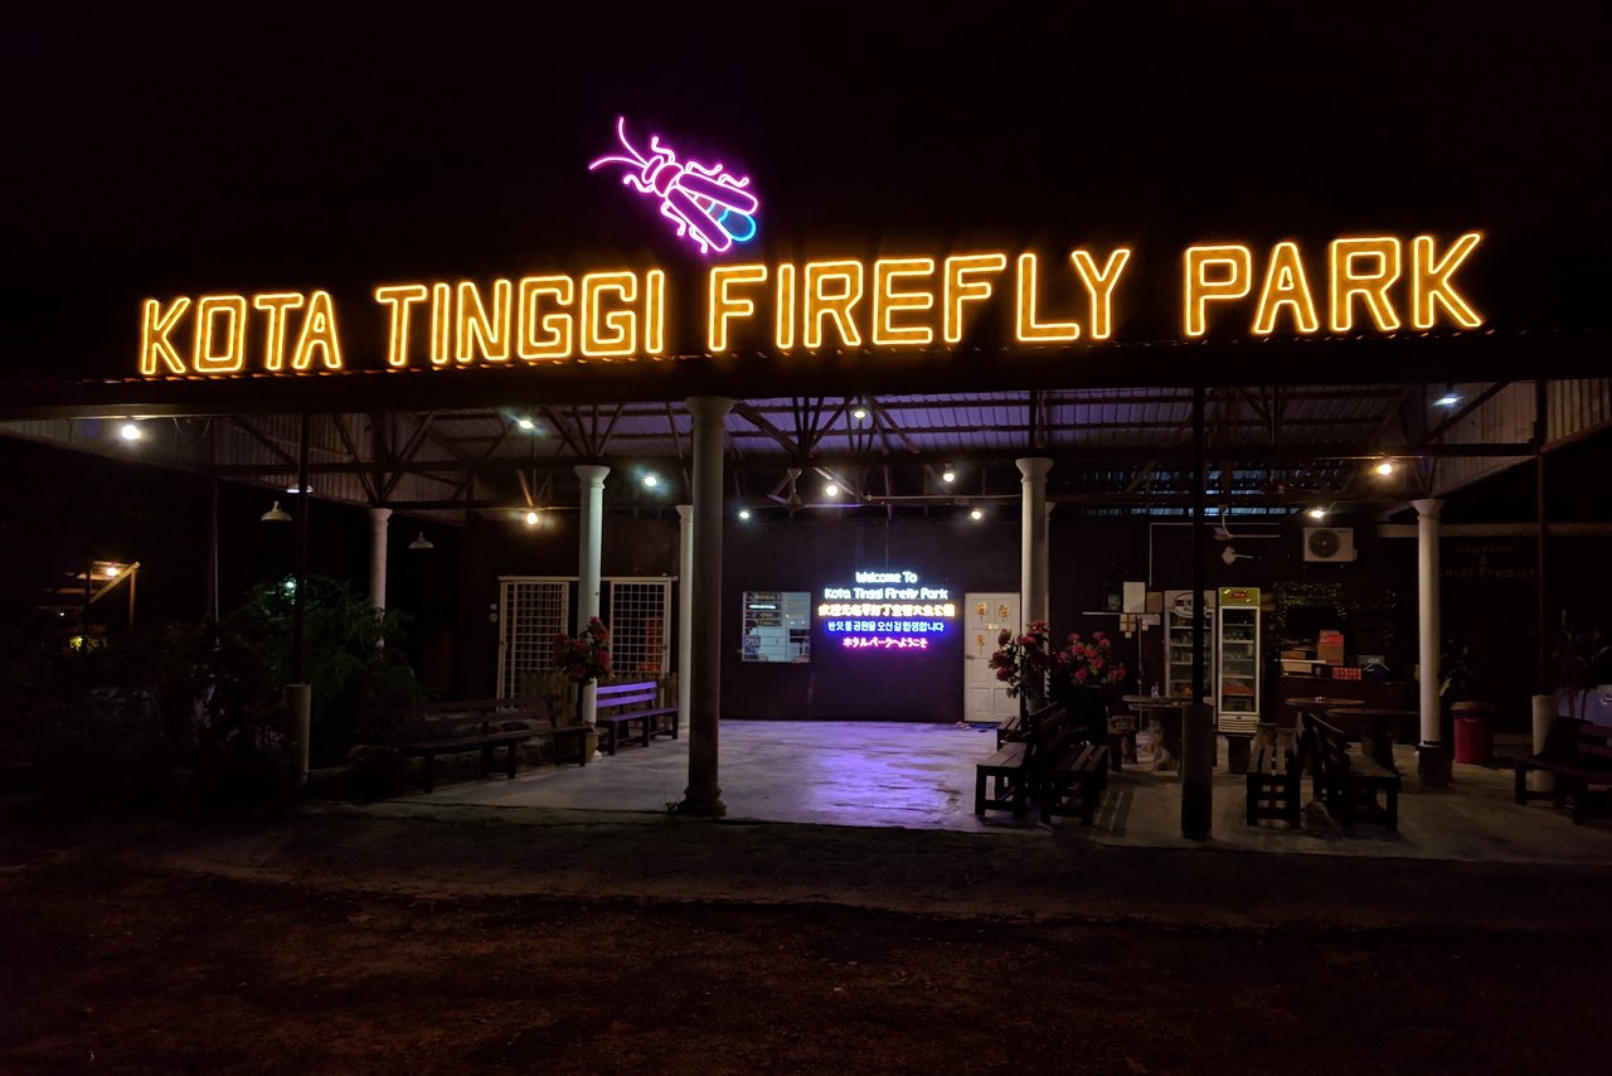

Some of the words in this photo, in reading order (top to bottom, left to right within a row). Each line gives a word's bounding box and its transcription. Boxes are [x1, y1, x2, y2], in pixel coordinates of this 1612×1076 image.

[139, 290, 343, 375] KOTA
[374, 267, 667, 368] TINGGI
[707, 247, 1132, 354] FIREFLY
[1183, 231, 1484, 338] PARK
[855, 571, 901, 583] Welcome
[902, 571, 918, 583] To
[1477, 566, 1535, 578] Product
[824, 587, 851, 599] Kota
[885, 587, 919, 600] Firefly
[920, 587, 949, 600] Park
